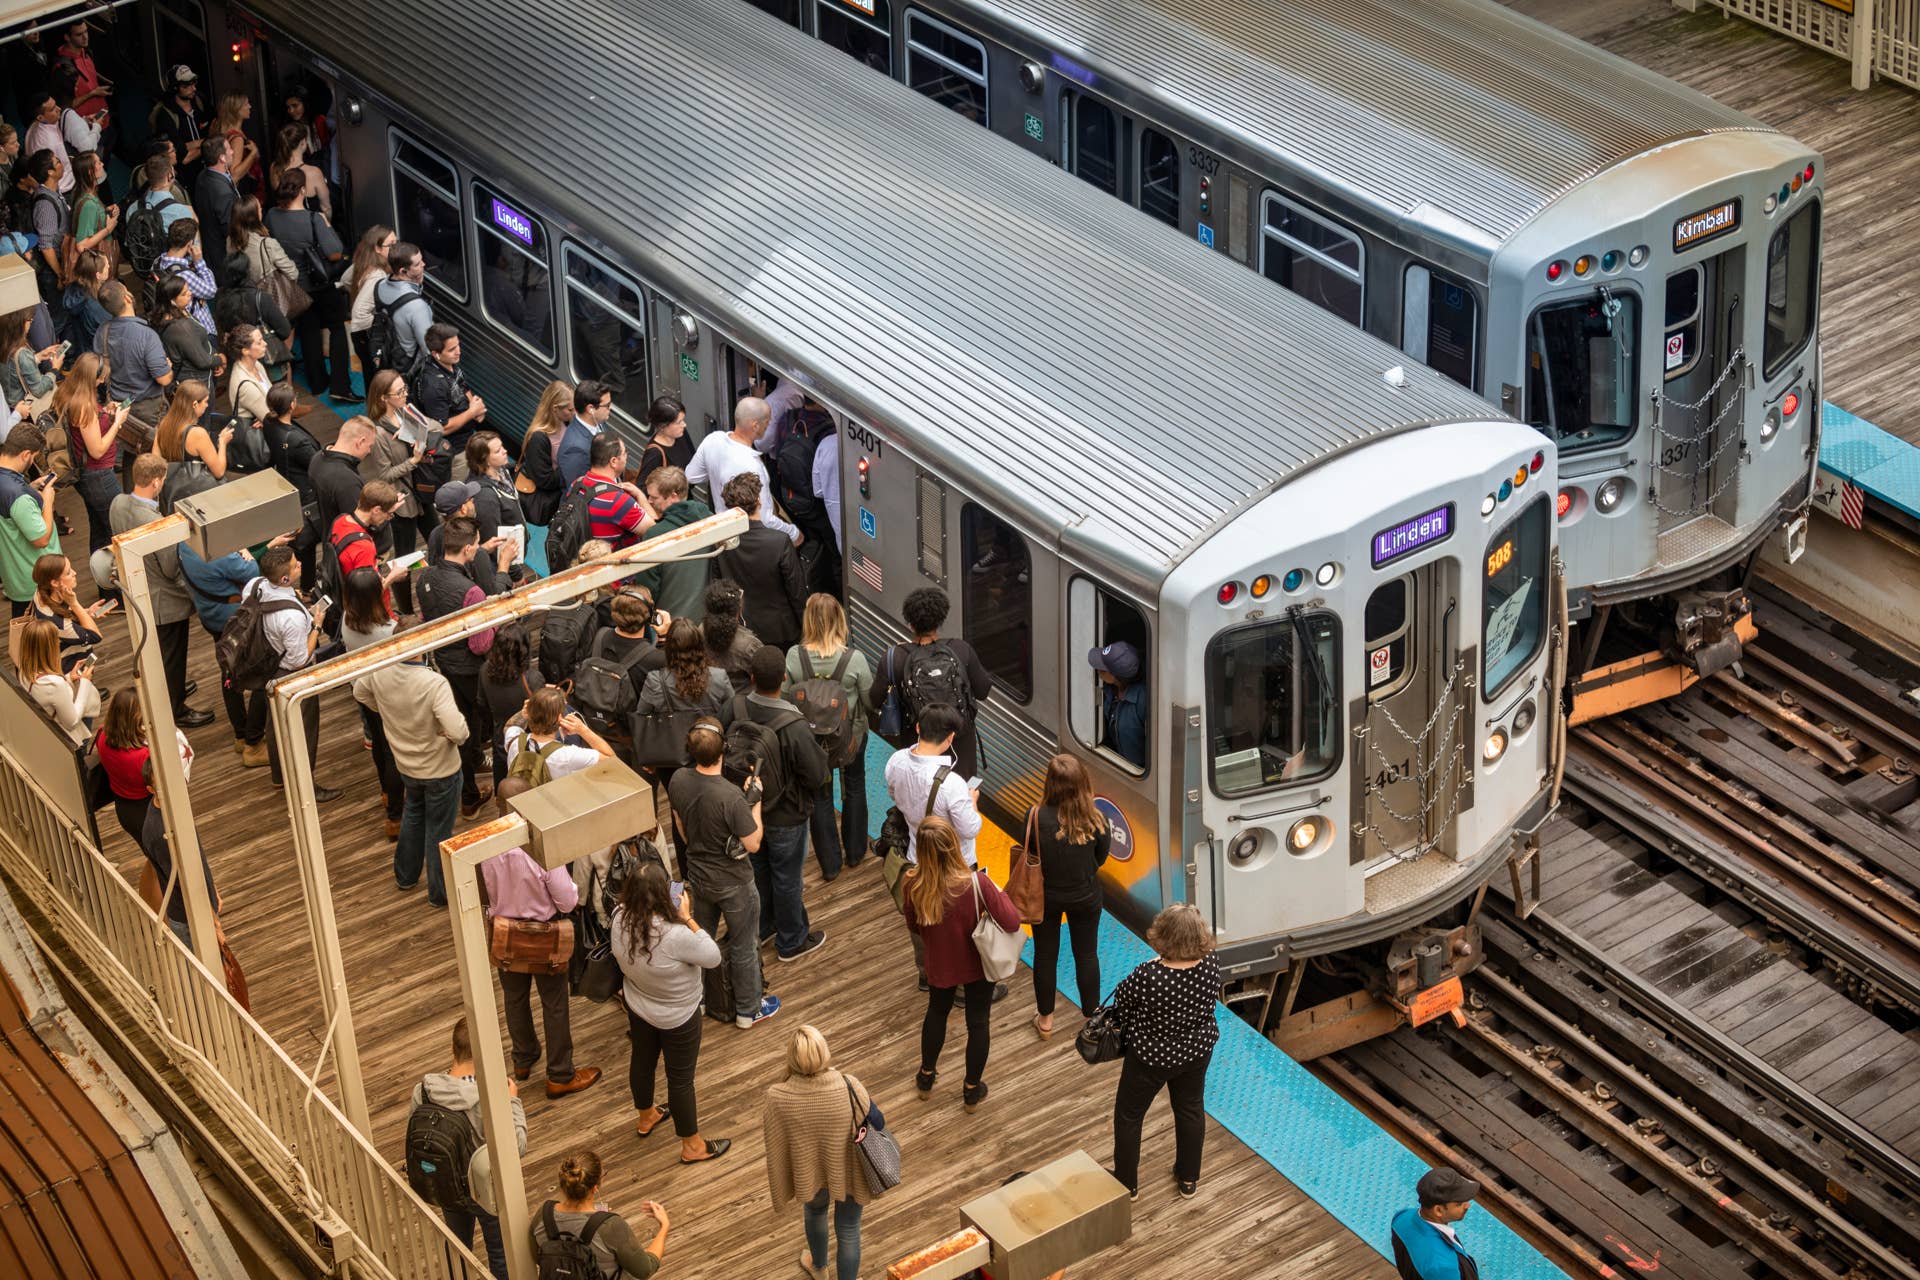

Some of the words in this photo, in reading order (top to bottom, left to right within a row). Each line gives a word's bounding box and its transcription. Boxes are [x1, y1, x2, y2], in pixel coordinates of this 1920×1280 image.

[1189, 147, 1220, 177] 3337
[497, 205, 531, 240] Linden
[1678, 202, 1733, 241] Kimball
[847, 420, 882, 459] 5401
[1661, 442, 1691, 467] 337
[1381, 517, 1442, 554] Linden
[1488, 541, 1511, 576] 508
